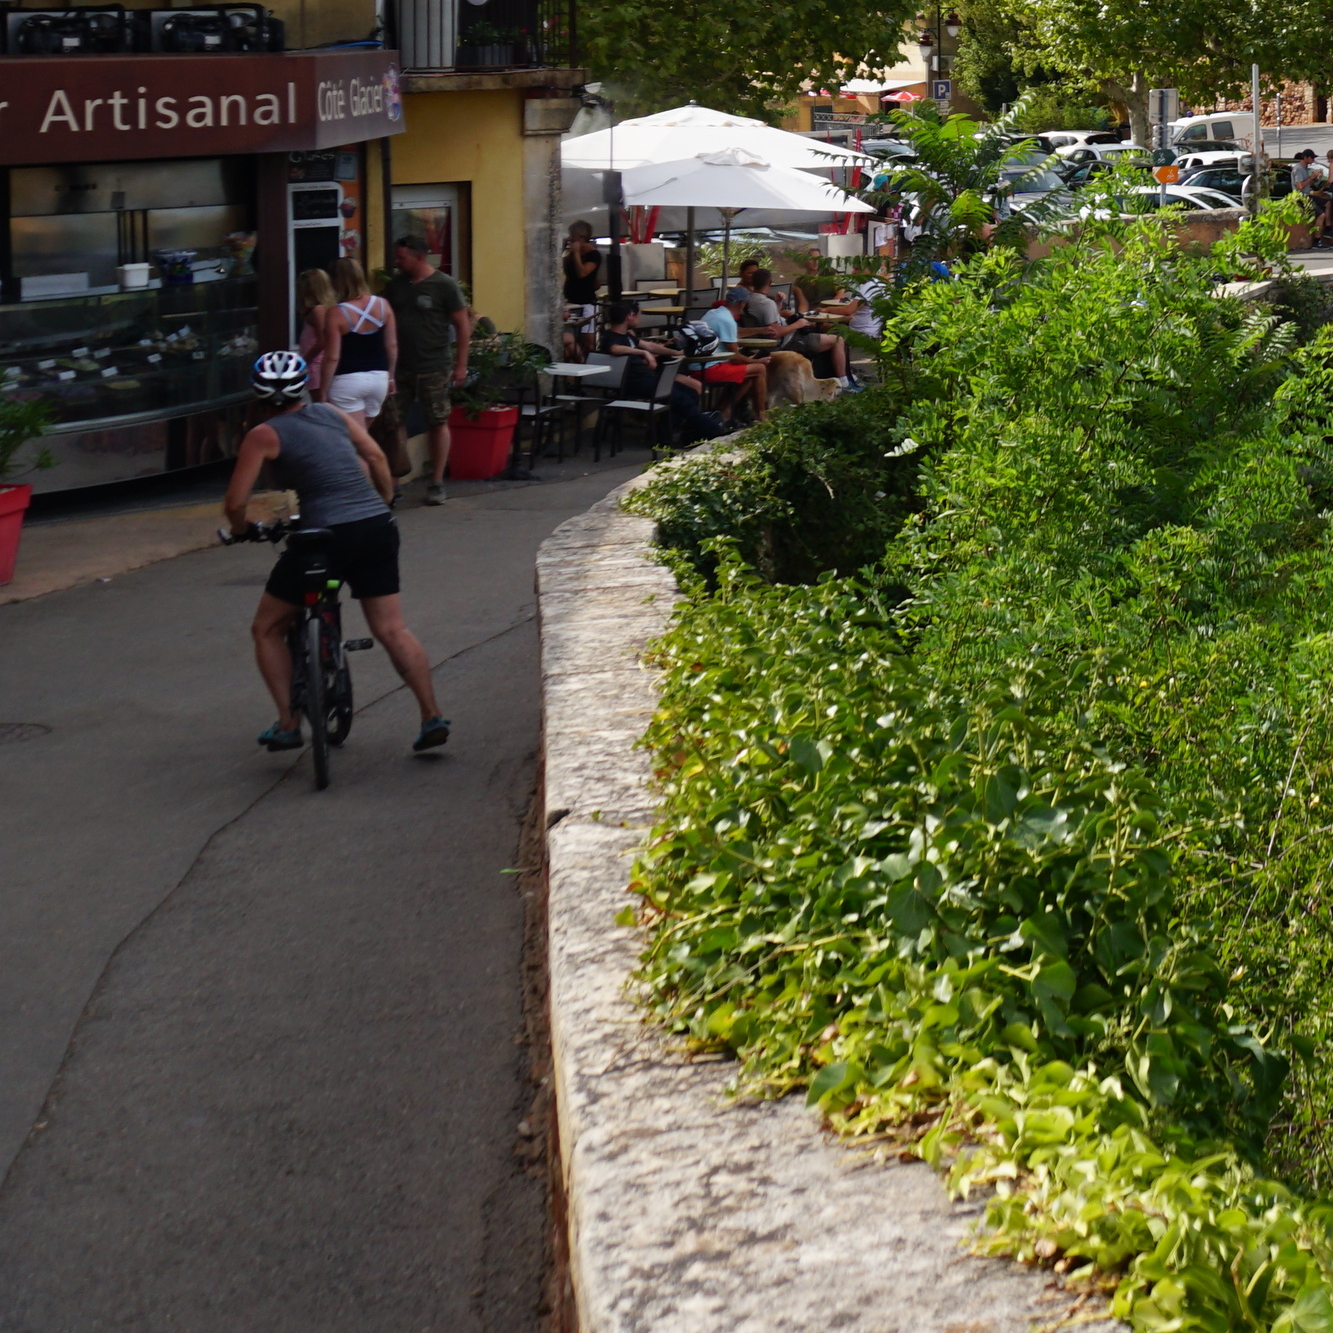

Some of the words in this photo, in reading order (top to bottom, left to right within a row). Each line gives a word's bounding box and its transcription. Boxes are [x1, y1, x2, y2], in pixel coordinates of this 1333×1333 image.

[39, 82, 297, 133] Artisanal
[317, 79, 345, 122] Côté
[349, 75, 384, 117] Glacier
[938, 84, 946, 96] P
